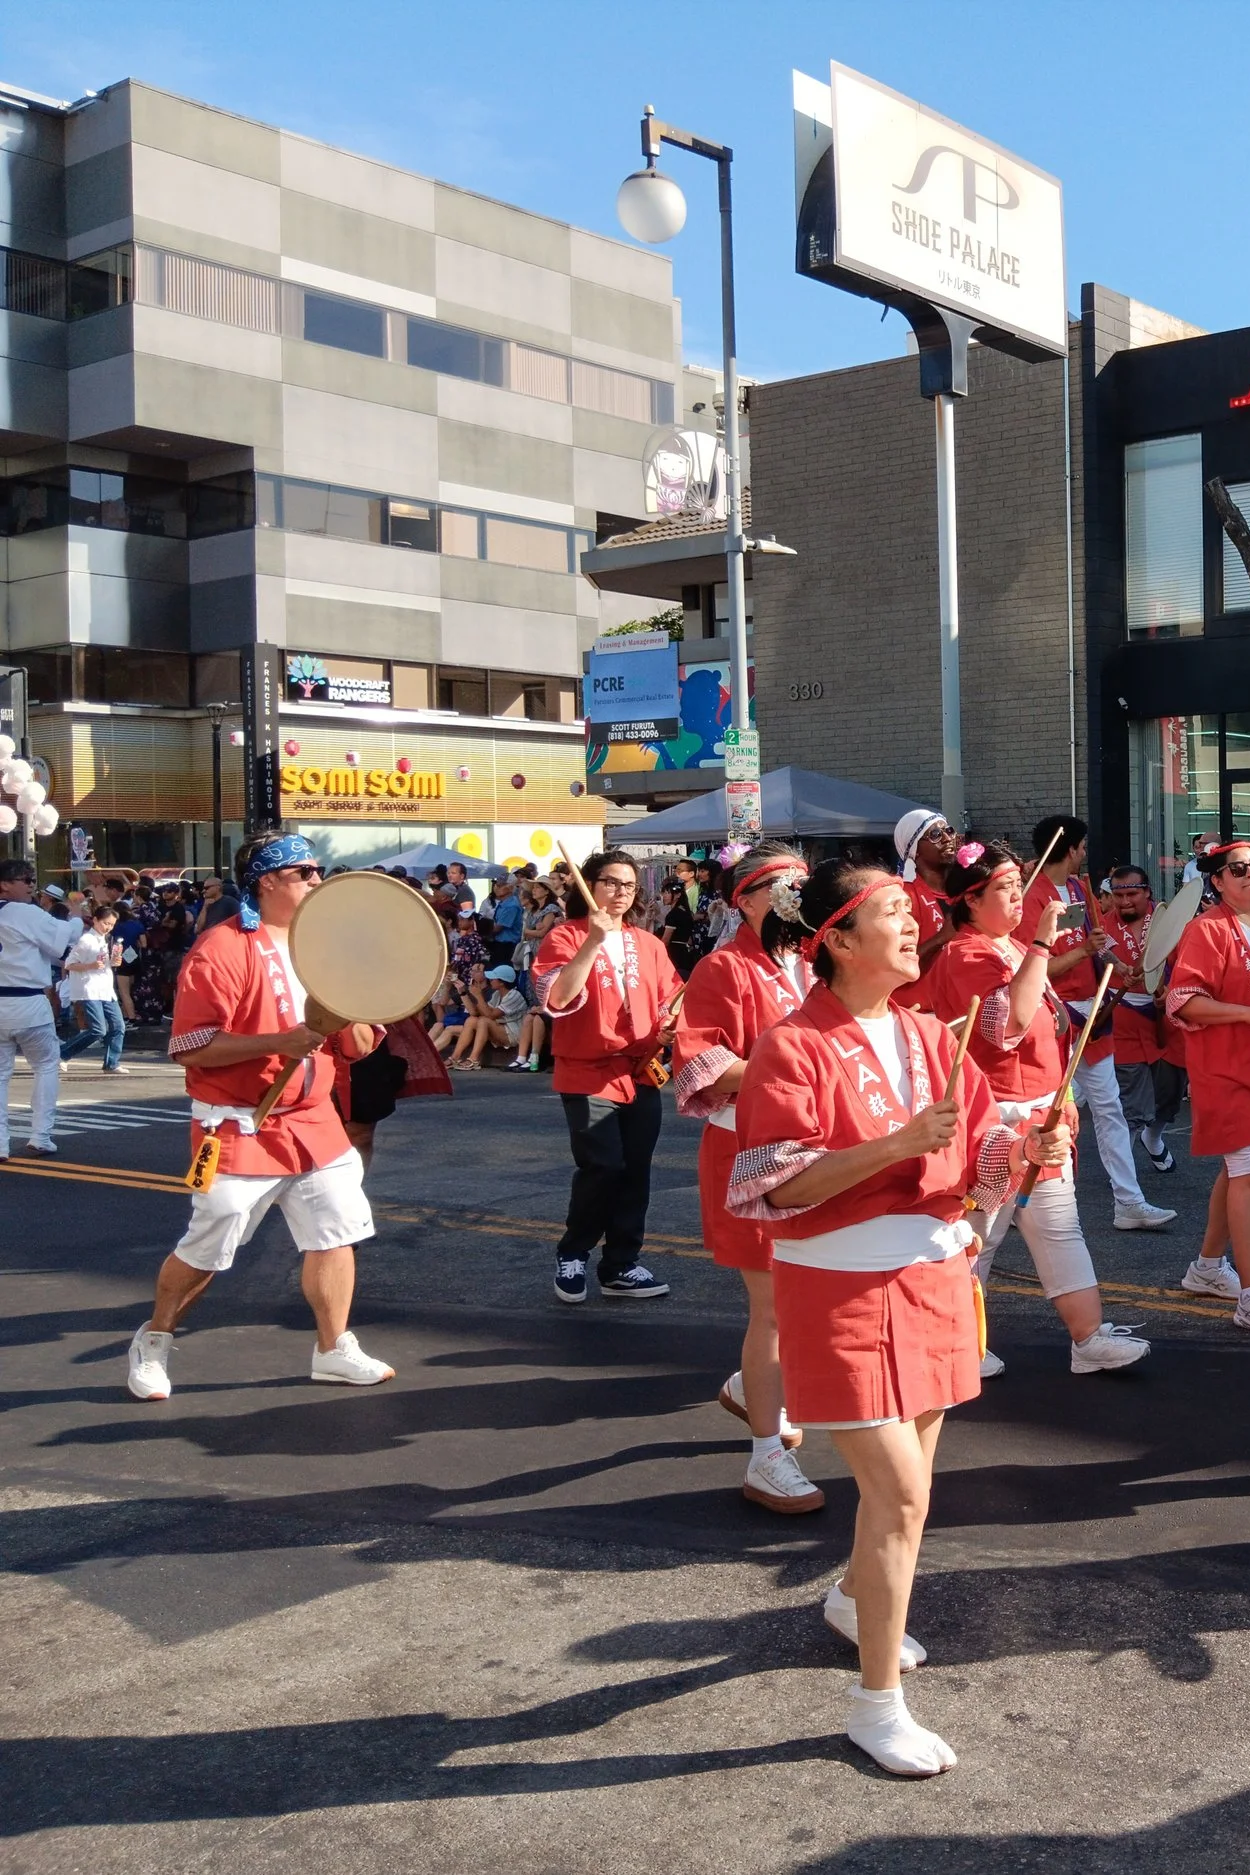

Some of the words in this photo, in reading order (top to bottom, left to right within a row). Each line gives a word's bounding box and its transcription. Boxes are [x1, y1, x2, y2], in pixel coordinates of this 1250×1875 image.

[891, 200, 942, 254] SHOE
[949, 226, 1020, 289] PALACE
[938, 269, 981, 300] リトル東京
[599, 640, 621, 649] Leasing
[628, 637, 664, 647] Management
[328, 677, 390, 690] WOODCRAFT
[593, 676, 625, 693] PCRE
[328, 687, 391, 703] RANGERS
[788, 681, 824, 701] 330
[265, 723, 271, 731] K
[611, 723, 630, 732] SCOTT
[631, 721, 655, 731] FURUTA
[608, 732, 624, 741] (818)
[625, 730, 659, 740] 433-0096
[729, 732, 736, 744] 2
[265, 740, 273, 809] HASHIMOTO
